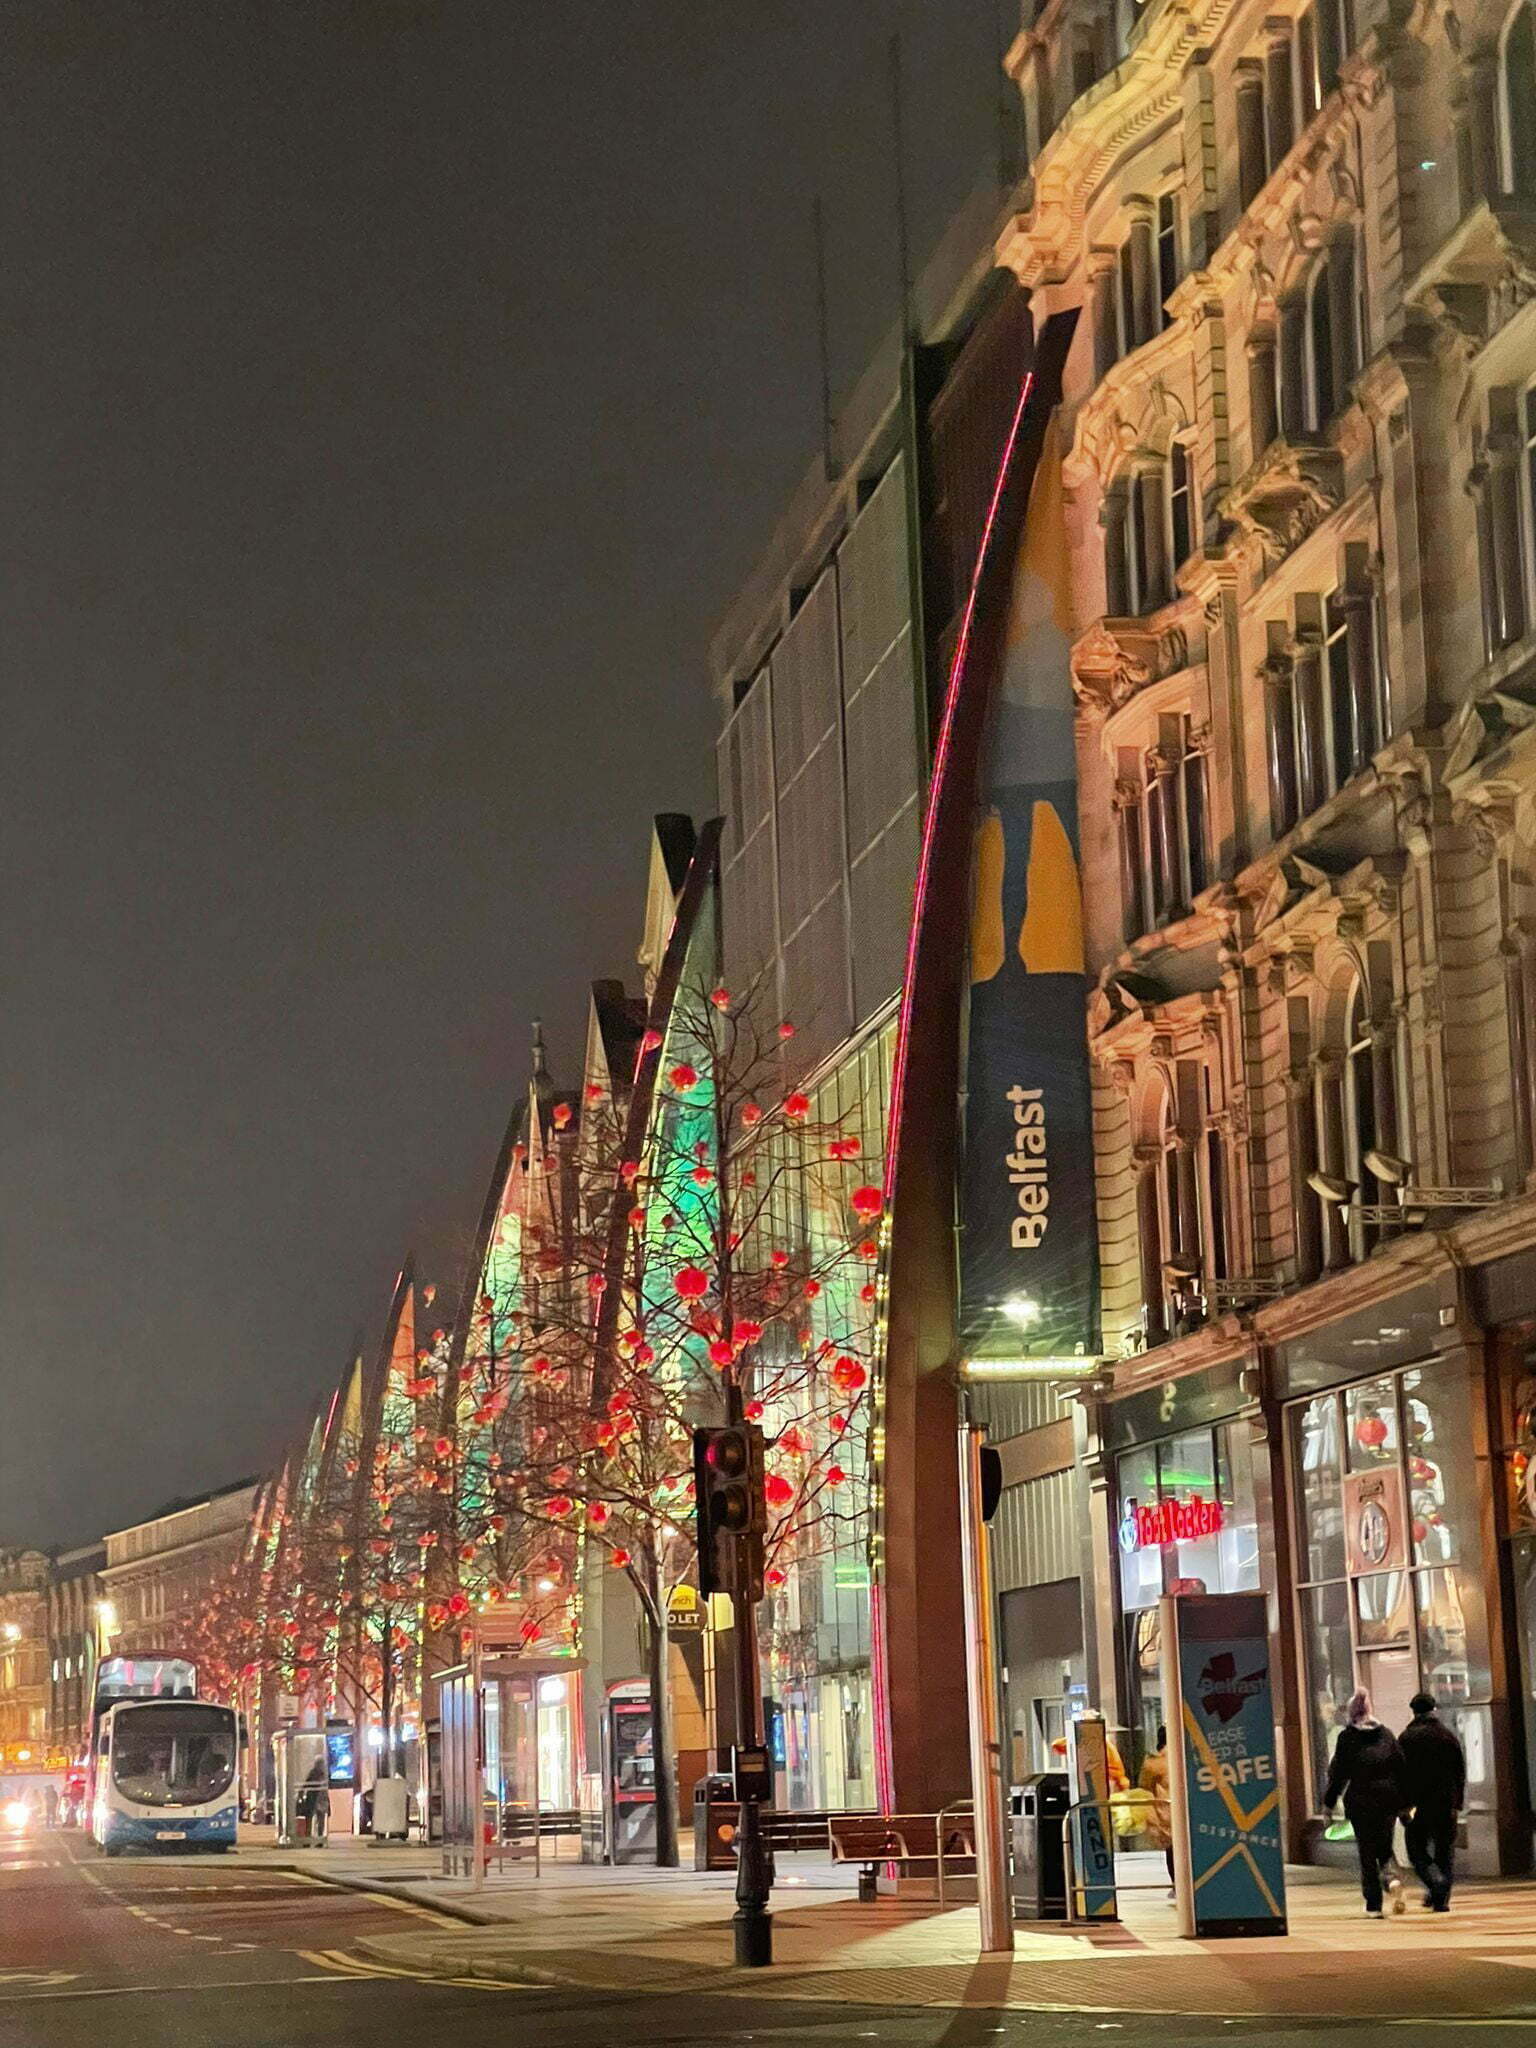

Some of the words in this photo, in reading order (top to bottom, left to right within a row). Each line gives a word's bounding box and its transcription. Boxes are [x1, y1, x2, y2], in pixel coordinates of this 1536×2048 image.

[1006, 1085, 1049, 1248] Belfast
[1167, 1495, 1218, 1540] Locker
[678, 1613, 700, 1624] LET
[1200, 1677, 1268, 1697] Belfast
[1196, 1755, 1273, 1792] SAFE
[1199, 1823, 1279, 1848] DISTANCE
